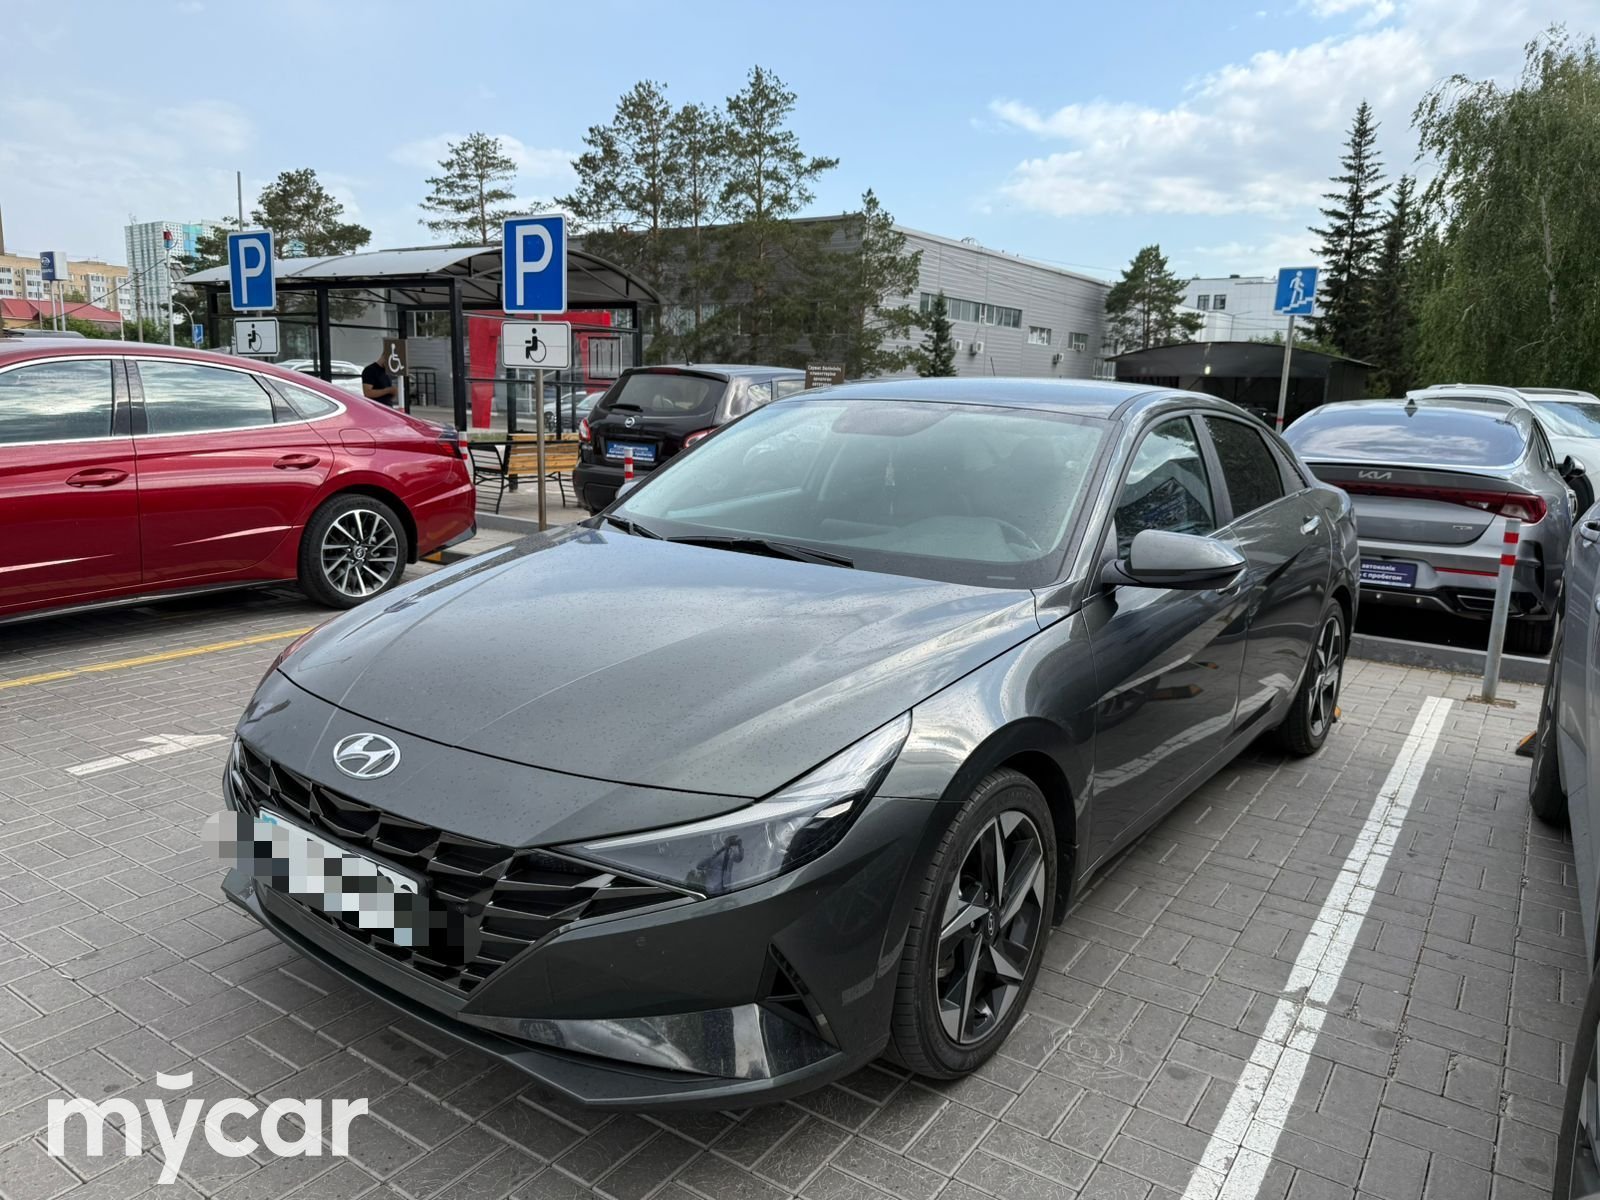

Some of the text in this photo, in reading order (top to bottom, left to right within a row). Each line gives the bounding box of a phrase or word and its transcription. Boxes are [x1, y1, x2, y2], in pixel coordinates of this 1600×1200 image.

[238, 238, 266, 304] P
[516, 224, 553, 306] P
[1358, 470, 1392, 480] KIA
